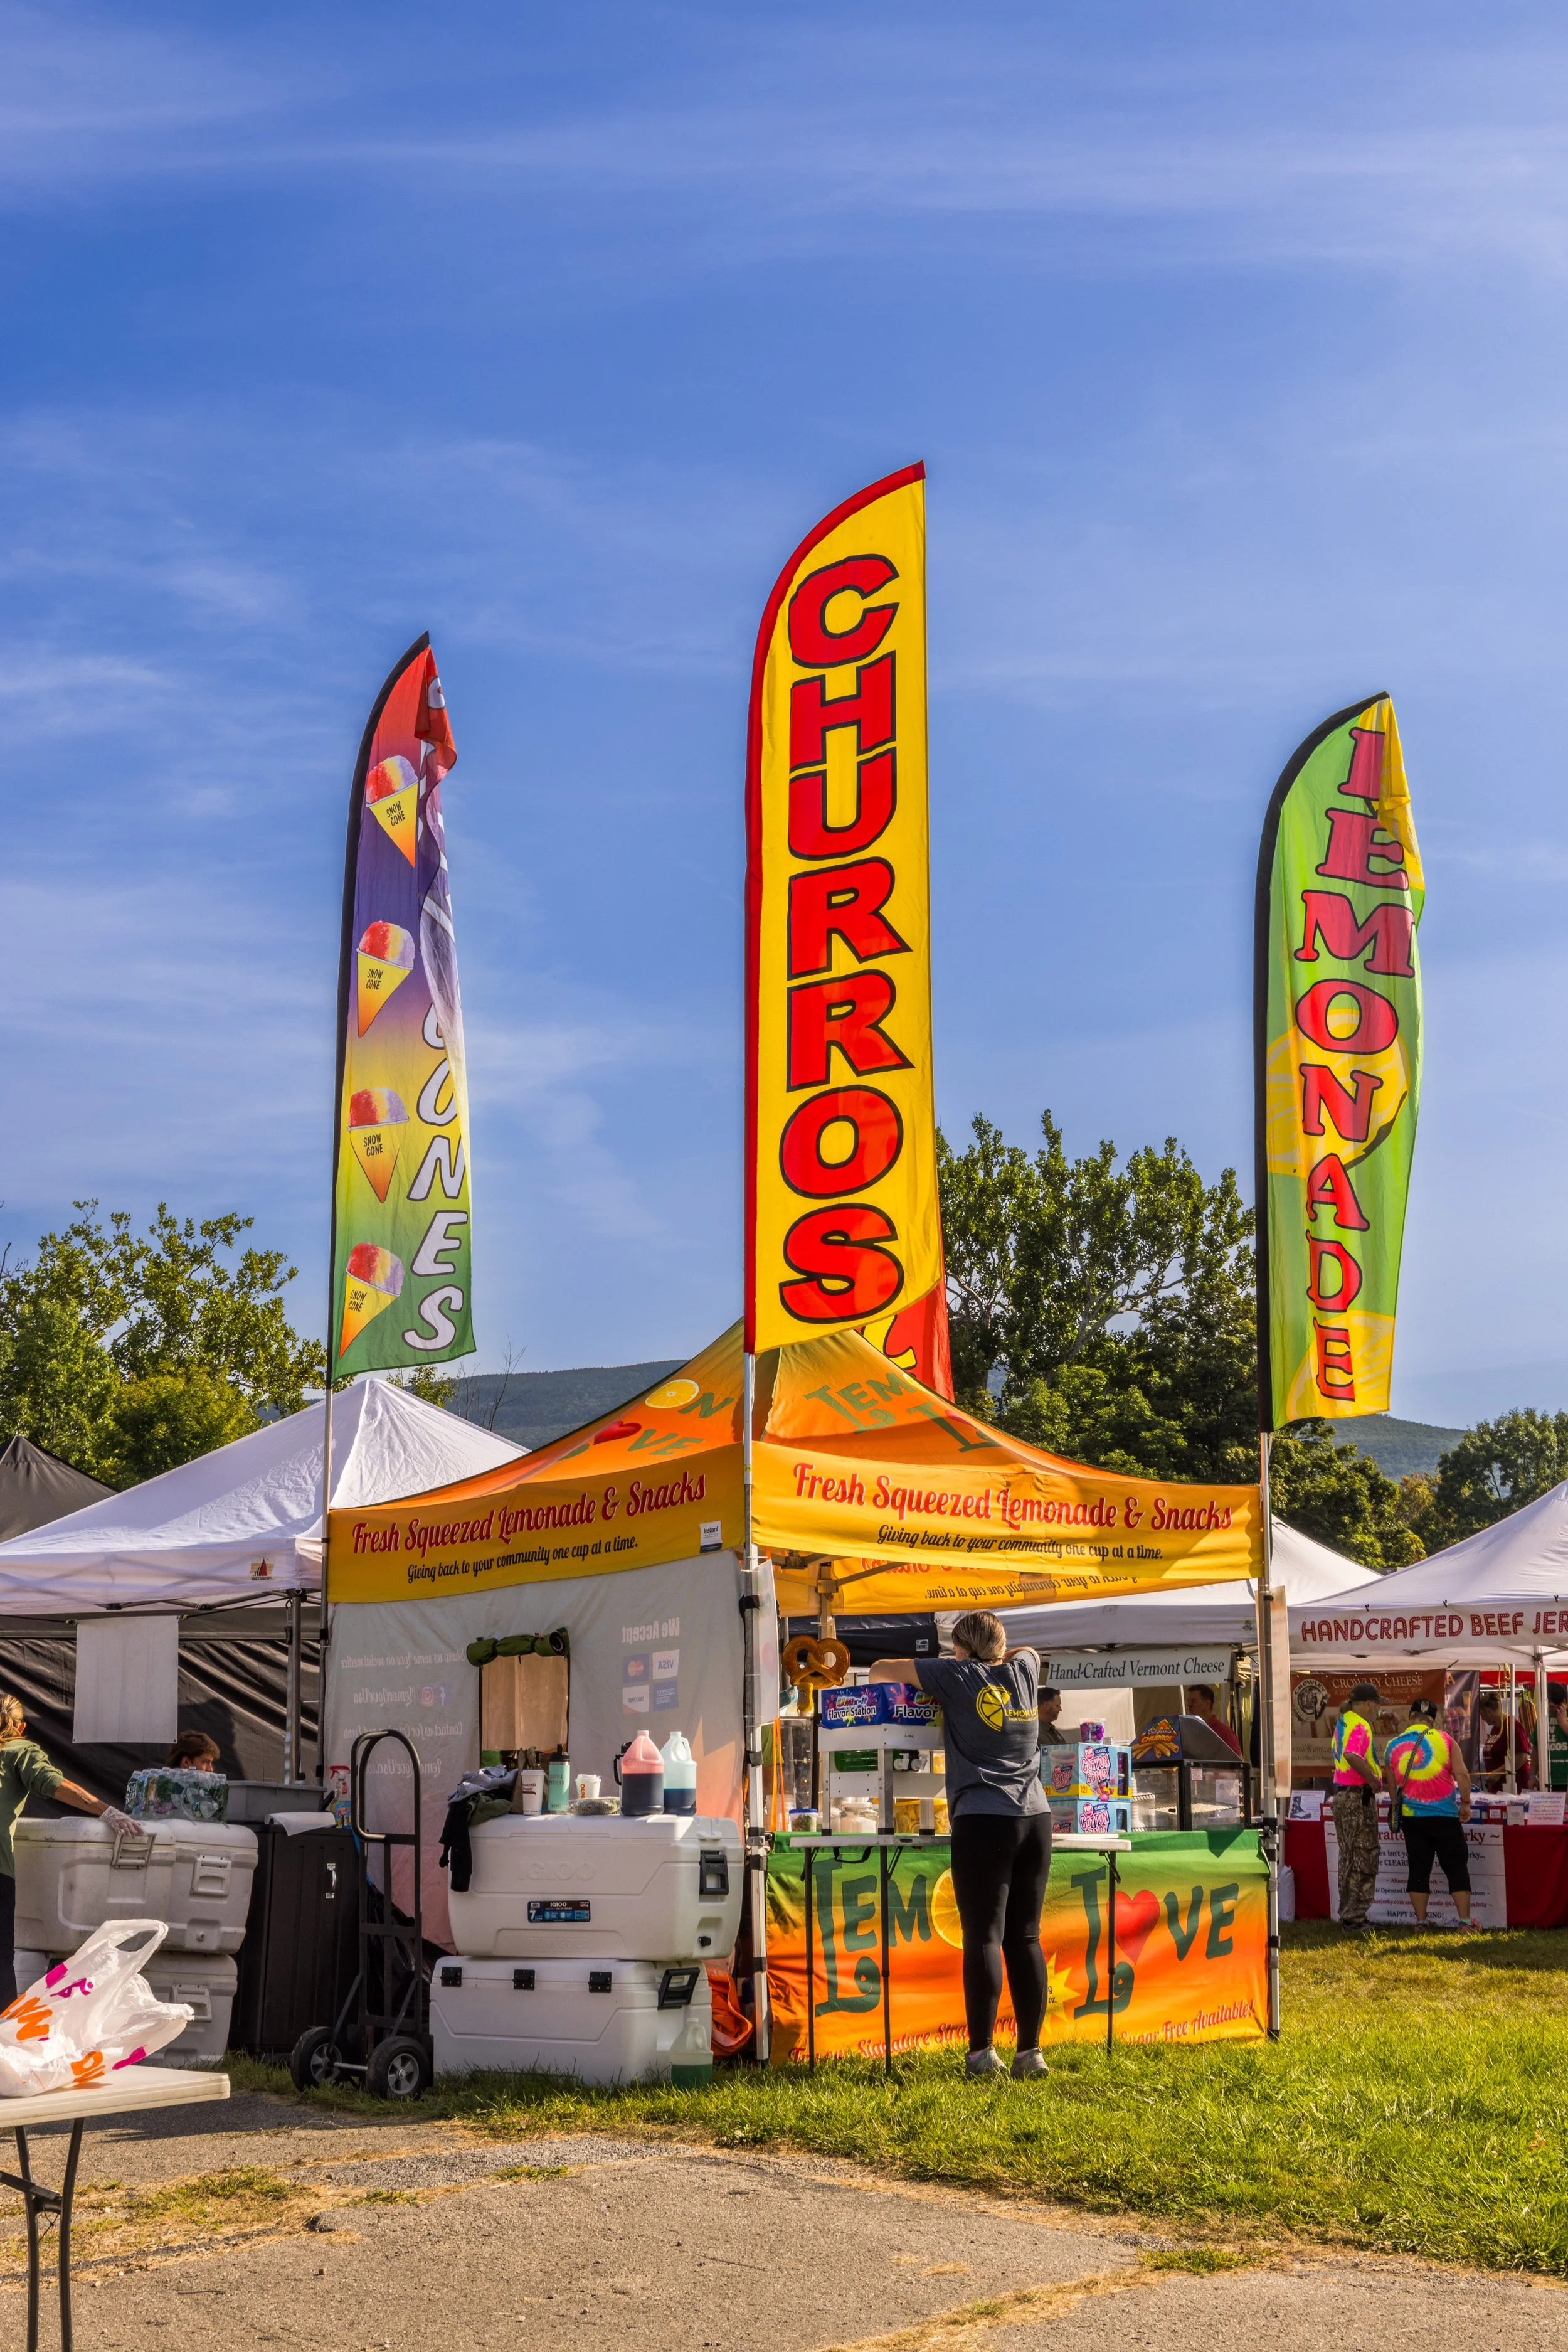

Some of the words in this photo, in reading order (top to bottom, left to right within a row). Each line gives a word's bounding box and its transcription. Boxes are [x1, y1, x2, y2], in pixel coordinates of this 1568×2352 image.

[386, 801, 402, 818] SNOW
[390, 811, 406, 827] CONE
[779, 553, 914, 1325] CHURROS
[367, 968, 383, 981] SNOW
[366, 978, 381, 990] CONE
[363, 1133, 381, 1147] SNOW
[366, 1143, 383, 1157] CONE
[350, 1289, 367, 1301] SNOW
[348, 1300, 364, 1312] CONE
[803, 1372, 917, 1435] LEM
[793, 1462, 866, 1506] Fresh
[872, 1476, 993, 1521] Squeezed
[996, 1489, 1118, 1531] Lemonade
[1123, 1496, 1145, 1530] &
[1150, 1497, 1232, 1531] Snacks
[352, 1521, 400, 1554] Fresh
[405, 1509, 495, 1558] Squeezed
[498, 1493, 596, 1545] Lemonade
[601, 1486, 622, 1521] &
[626, 1471, 706, 1517] Snacks
[703, 1526, 719, 1534] Instant
[877, 1525, 920, 1548] Giving
[920, 1530, 951, 1547] back
[952, 1533, 965, 1548] to
[967, 1538, 998, 1553] your
[998, 1538, 1062, 1558] community
[1066, 1543, 1085, 1556] one
[1088, 1545, 1109, 1562] cup
[1112, 1545, 1124, 1558] at
[1126, 1548, 1135, 1558] a
[1136, 1545, 1163, 1560] time.
[408, 1565, 436, 1584] Giving
[438, 1561, 460, 1577] back
[462, 1560, 470, 1573] to
[473, 1558, 494, 1577] your
[496, 1546, 549, 1568] community
[553, 1548, 569, 1560] one
[571, 1543, 588, 1562] cup
[591, 1540, 602, 1555] at
[604, 1541, 611, 1553] a
[613, 1536, 638, 1552] time.
[1301, 1615, 1464, 1642] HANDCRAFTED
[1470, 1612, 1524, 1637] BEEF
[1049, 1661, 1126, 1680] Hand-Crafted
[1130, 1660, 1180, 1677] Vermont
[1184, 1656, 1224, 1674] Cheese
[1295, 1679, 1327, 1694] CROWLEY
[1385, 1675, 1423, 1686] CHEESE
[828, 1708, 849, 1720] Flavor
[850, 1705, 877, 1716] Station
[894, 1704, 939, 1718] Flavor
[1004, 1708, 1030, 1718] LEMON
[1030, 1705, 1038, 1716] LOV
[1141, 1735, 1172, 1743] CHURROS
[1291, 1742, 1332, 1754] ward-Winning
[1081, 1753, 1110, 1773] COTTON
[1080, 1785, 1086, 1794] 12
[1079, 1811, 1109, 1831] COTTON
[1465, 1829, 1485, 1845] rky
[517, 1860, 596, 1881] IGLOO
[529, 1910, 536, 1920] 7
[812, 1858, 933, 2017] LEM
[1162, 2021, 1188, 2041] Free
[1192, 1999, 1255, 2035] Available!
[858, 2033, 931, 2058] Sigature
